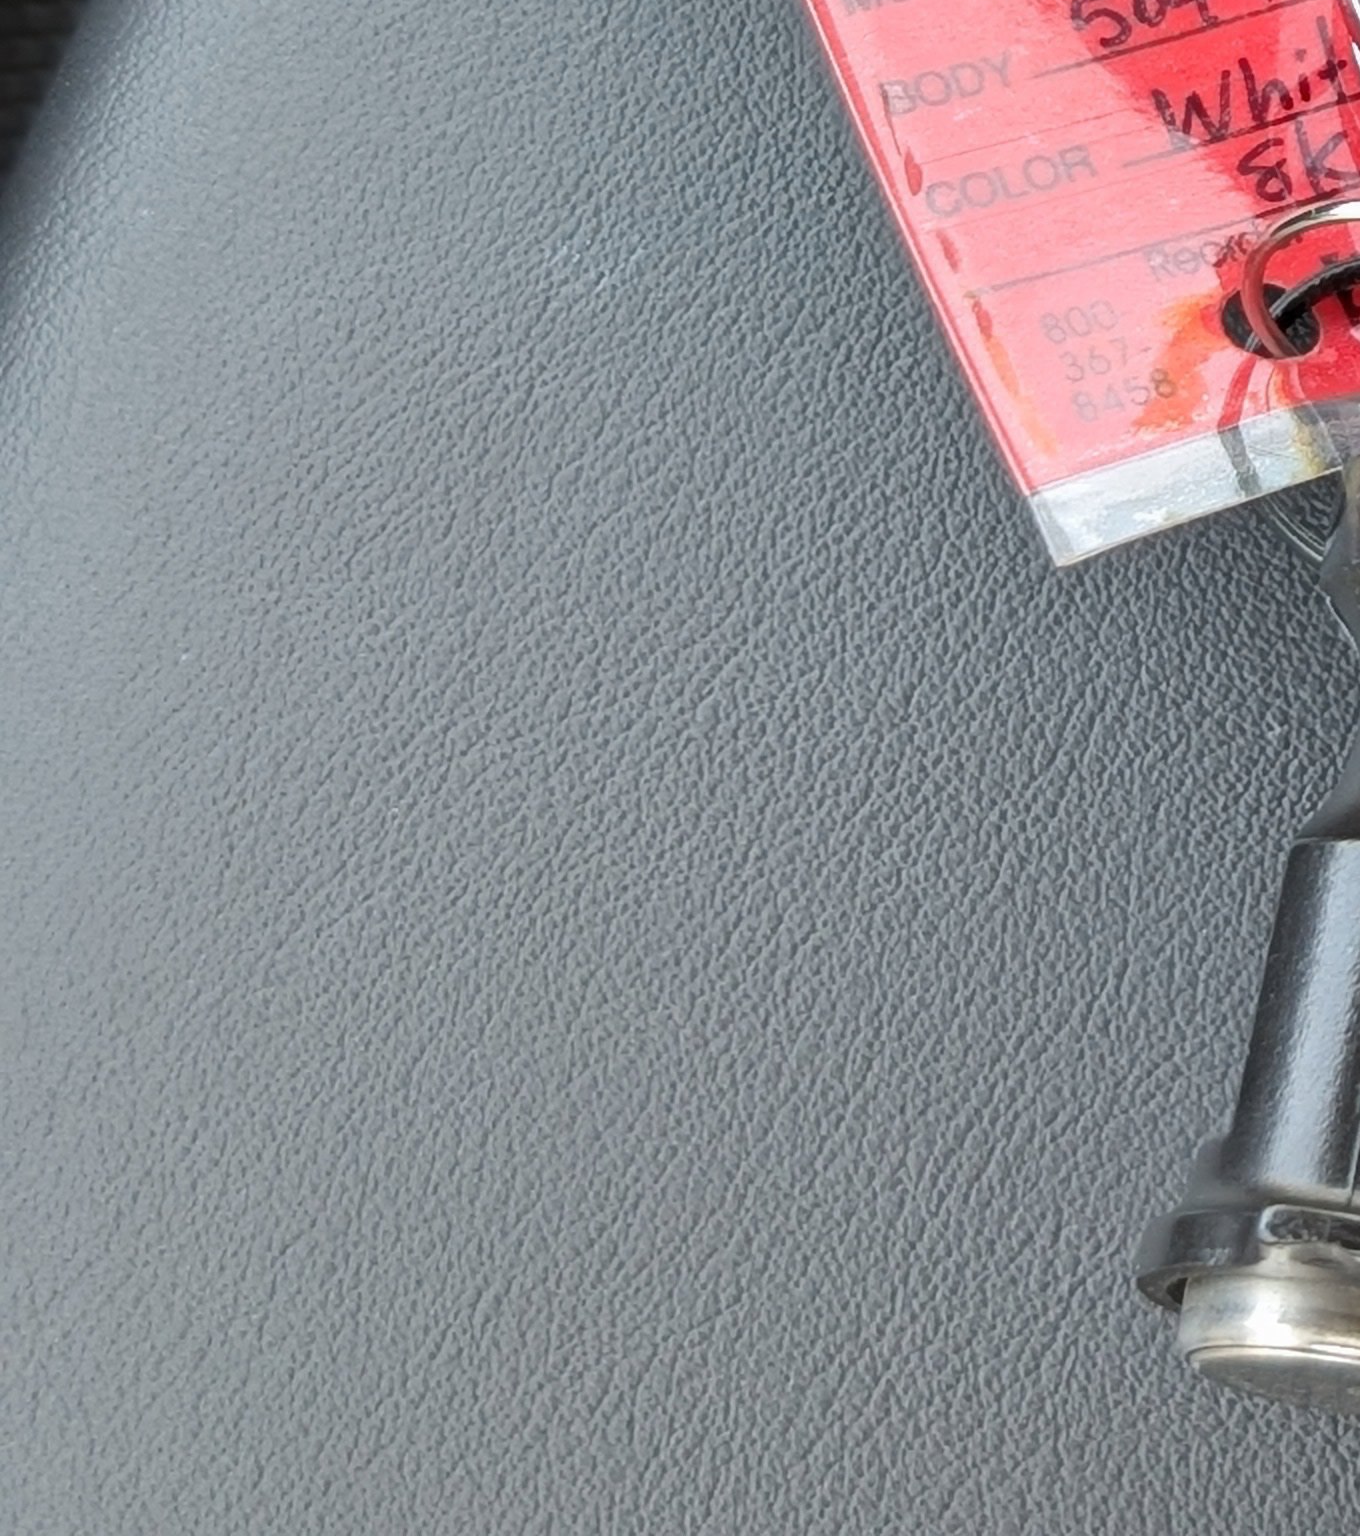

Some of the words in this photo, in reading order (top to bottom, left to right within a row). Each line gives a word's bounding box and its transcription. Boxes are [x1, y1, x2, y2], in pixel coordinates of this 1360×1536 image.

[880, 49, 1016, 117] BODY
[1152, 16, 1350, 154] Whit
[923, 144, 1100, 219] COLOR
[1073, 369, 1177, 422] 8458
